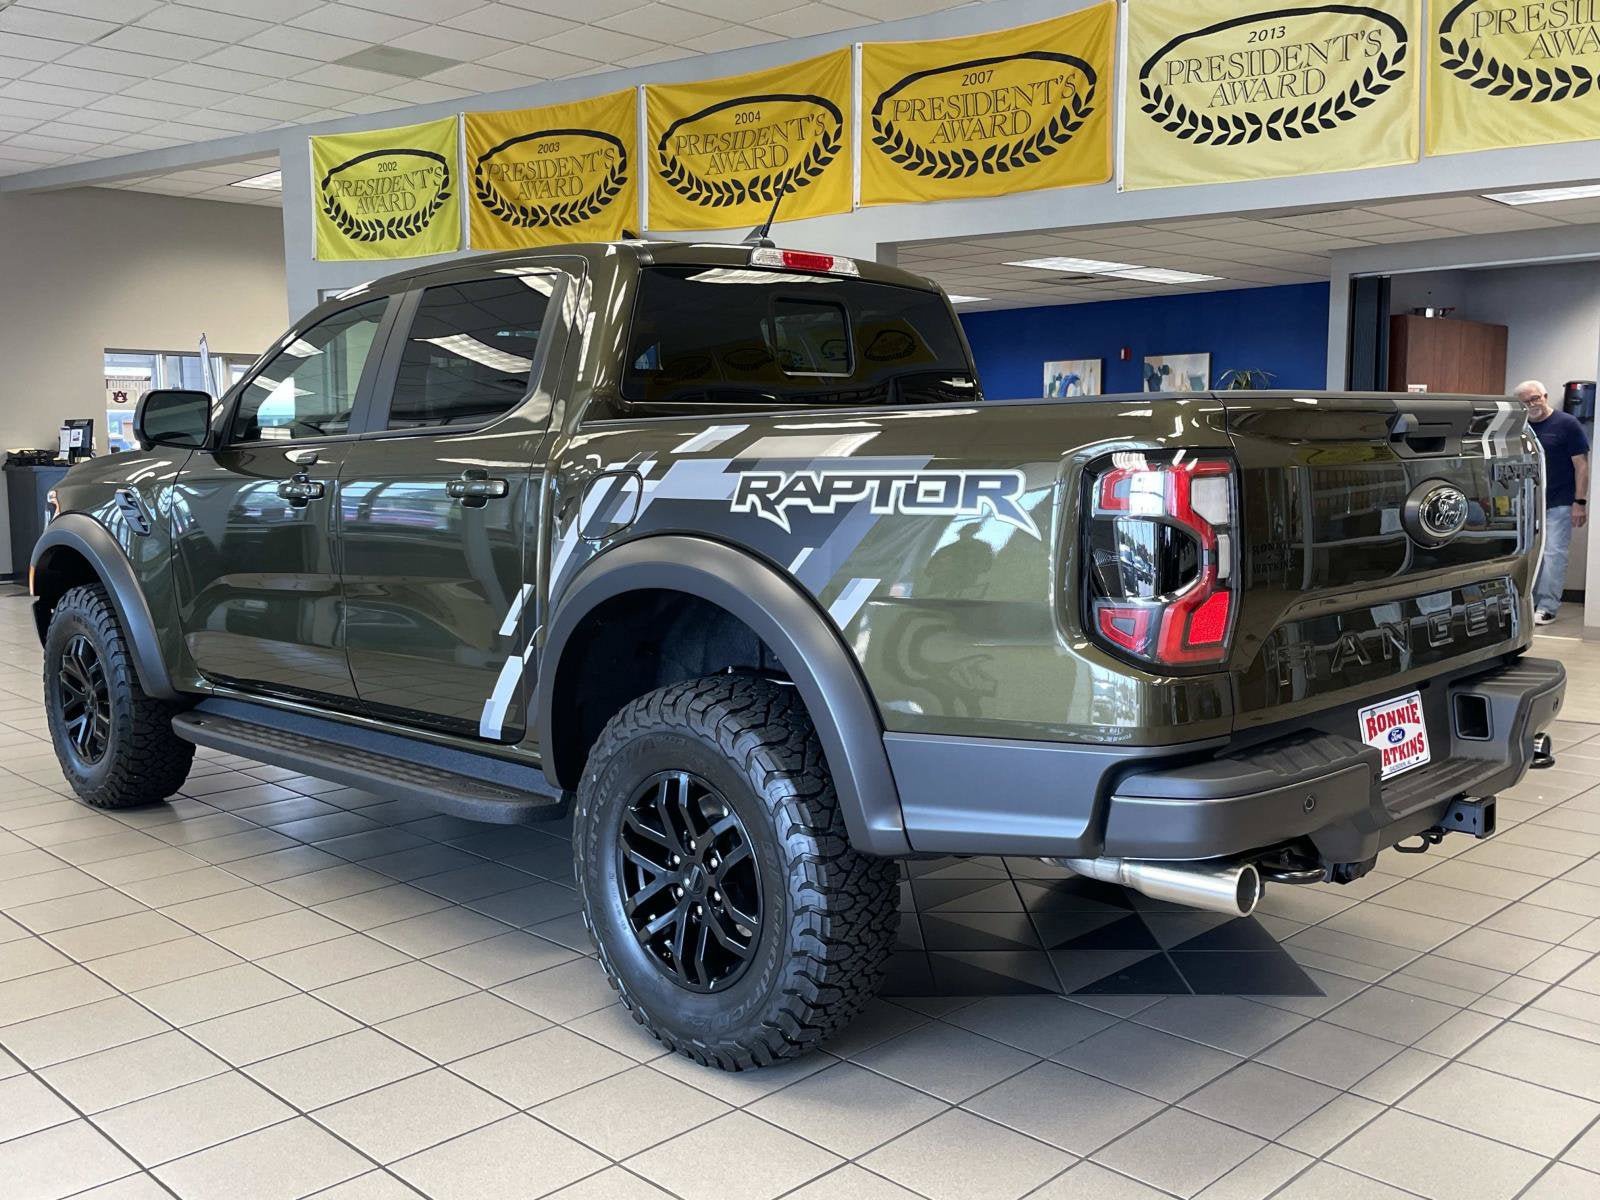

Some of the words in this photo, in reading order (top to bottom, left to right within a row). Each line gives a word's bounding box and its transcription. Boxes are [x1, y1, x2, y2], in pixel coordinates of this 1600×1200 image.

[1247, 25, 1286, 44] 2013
[1163, 28, 1382, 87] PRESIDENT'S
[962, 69, 995, 87] 2007
[1206, 67, 1327, 110] AWARD
[892, 72, 1077, 122] PRESIDENT'S
[676, 112, 827, 156] PRESIDENT'S
[734, 110, 761, 126] 2004
[930, 109, 1032, 145] AWARD
[537, 142, 561, 154] 2003
[704, 143, 790, 176] AWARD
[377, 161, 398, 173] 2002
[486, 147, 616, 183] PRESIDENT'S
[333, 166, 444, 198] PRESIDENT'S
[517, 175, 584, 201] AWARD
[355, 192, 417, 215] AWARD
[729, 469, 1043, 542] RAPTOR
[1366, 703, 1420, 742] RONNIE
[1389, 728, 1404, 743] Ford
[1382, 731, 1425, 767] ATKINS
